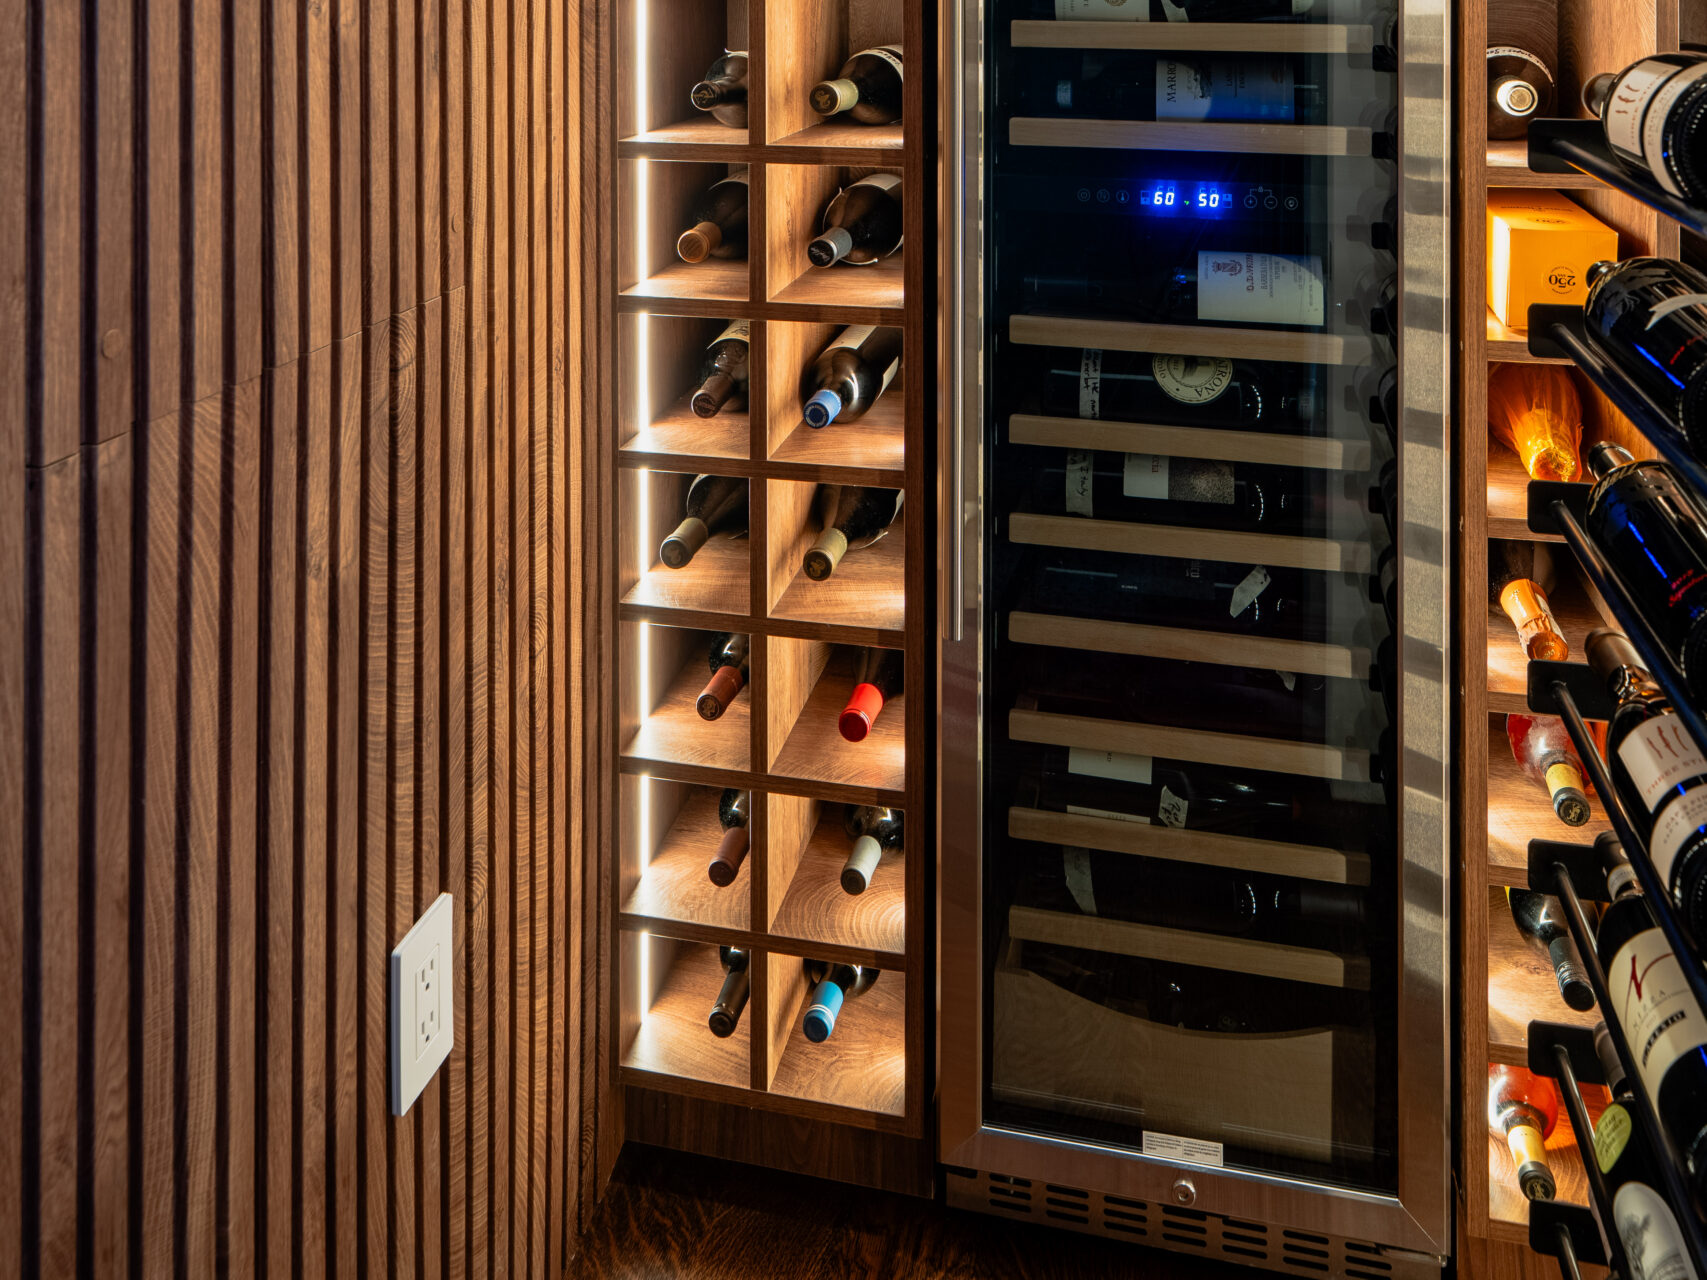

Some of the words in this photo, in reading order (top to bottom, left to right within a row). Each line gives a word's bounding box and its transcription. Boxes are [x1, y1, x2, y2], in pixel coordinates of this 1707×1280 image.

[1153, 192, 1175, 206] 60
[1198, 193, 1220, 208] 50
[1548, 274, 1576, 288] 250
